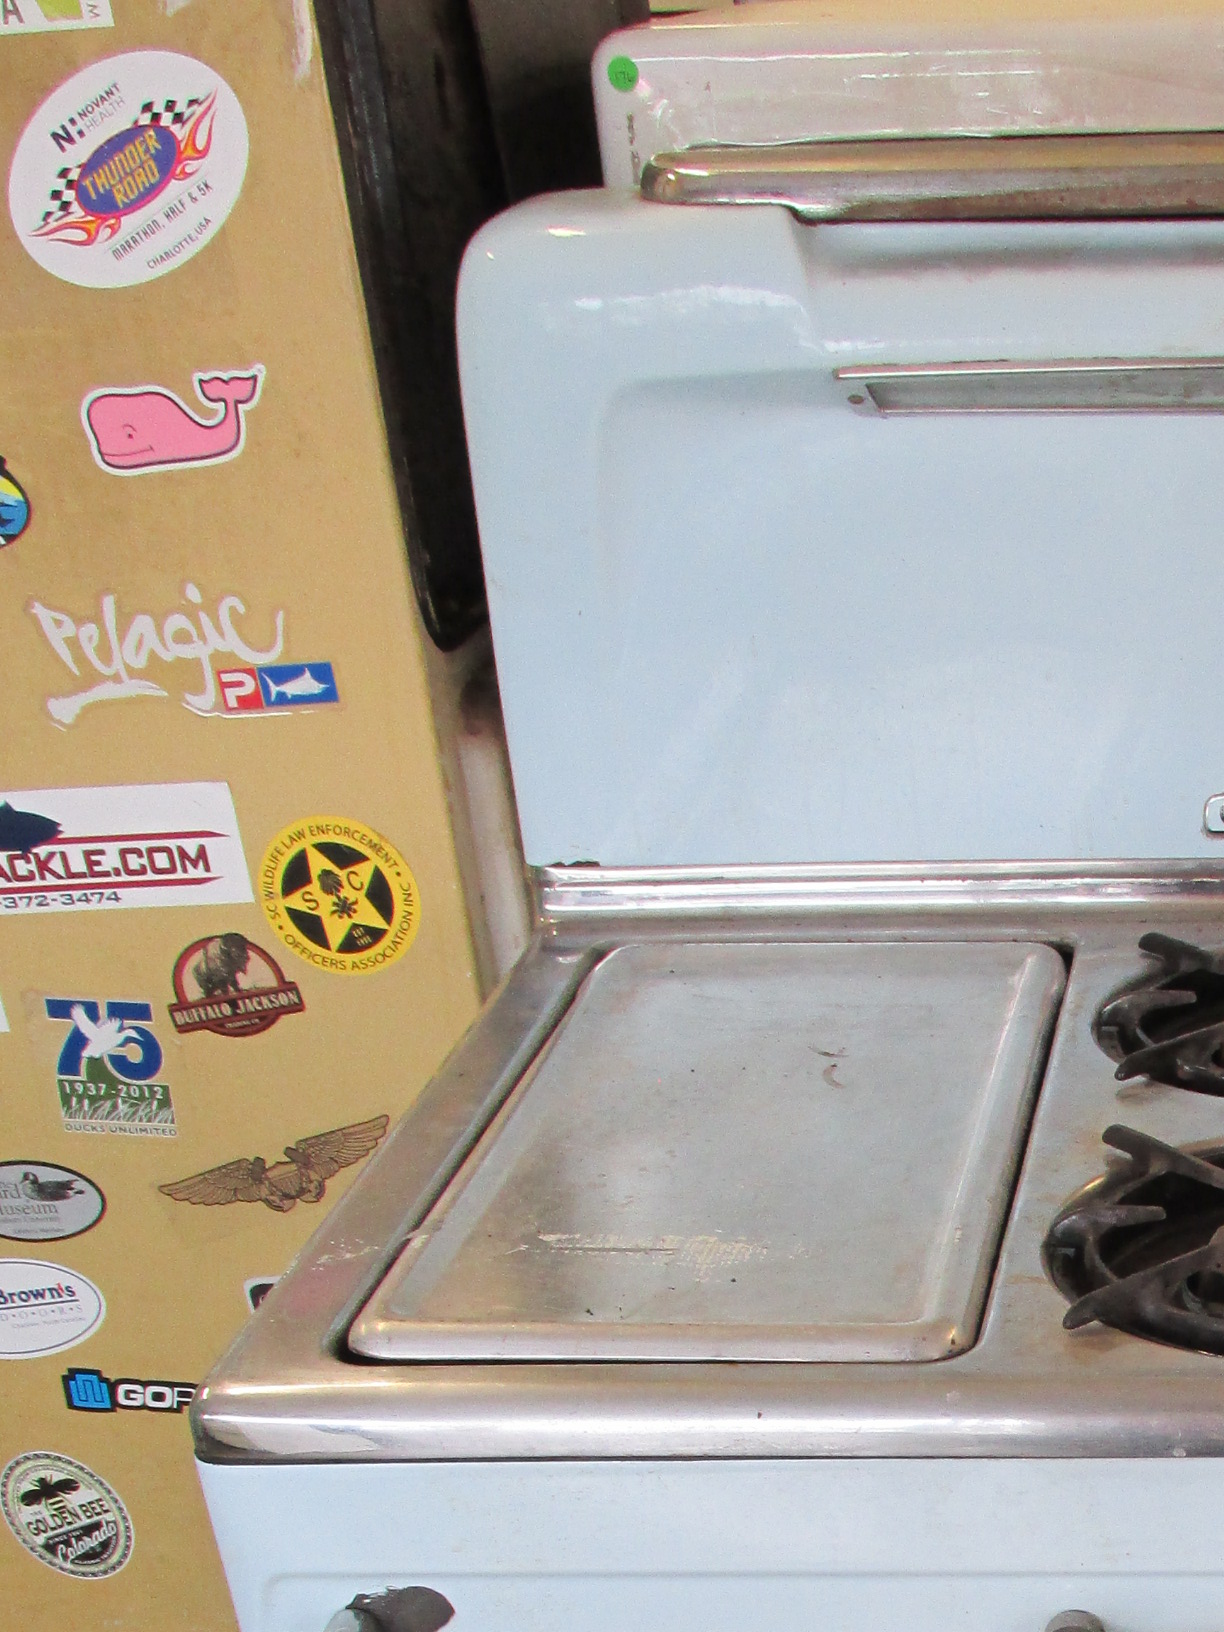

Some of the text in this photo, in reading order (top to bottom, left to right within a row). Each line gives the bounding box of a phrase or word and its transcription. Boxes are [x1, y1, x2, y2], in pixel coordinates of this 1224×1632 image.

[77, 83, 121, 121] NOVANT
[85, 95, 126, 132] HEALTH
[82, 127, 161, 200] THUNDER
[111, 157, 159, 209] ROAD
[111, 180, 213, 262] MARATHON, HALF & 5K
[220, 672, 256, 707] P
[262, 846, 286, 900] WILDLIFE
[281, 828, 306, 850] LAW
[308, 823, 398, 869] ENFORCEMENT
[284, 933, 347, 971] OFFICERS
[351, 910, 413, 971] ASSOCIATION
[399, 882, 414, 907] INC
[172, 990, 300, 1026] BUFFALO JACKSON
[44, 998, 163, 1082] 75
[64, 1122, 177, 1137] DUCKS UNLIMITED
[27, 1498, 111, 1537] GOLDEN BEE
[58, 1520, 117, 1565] Colorado
